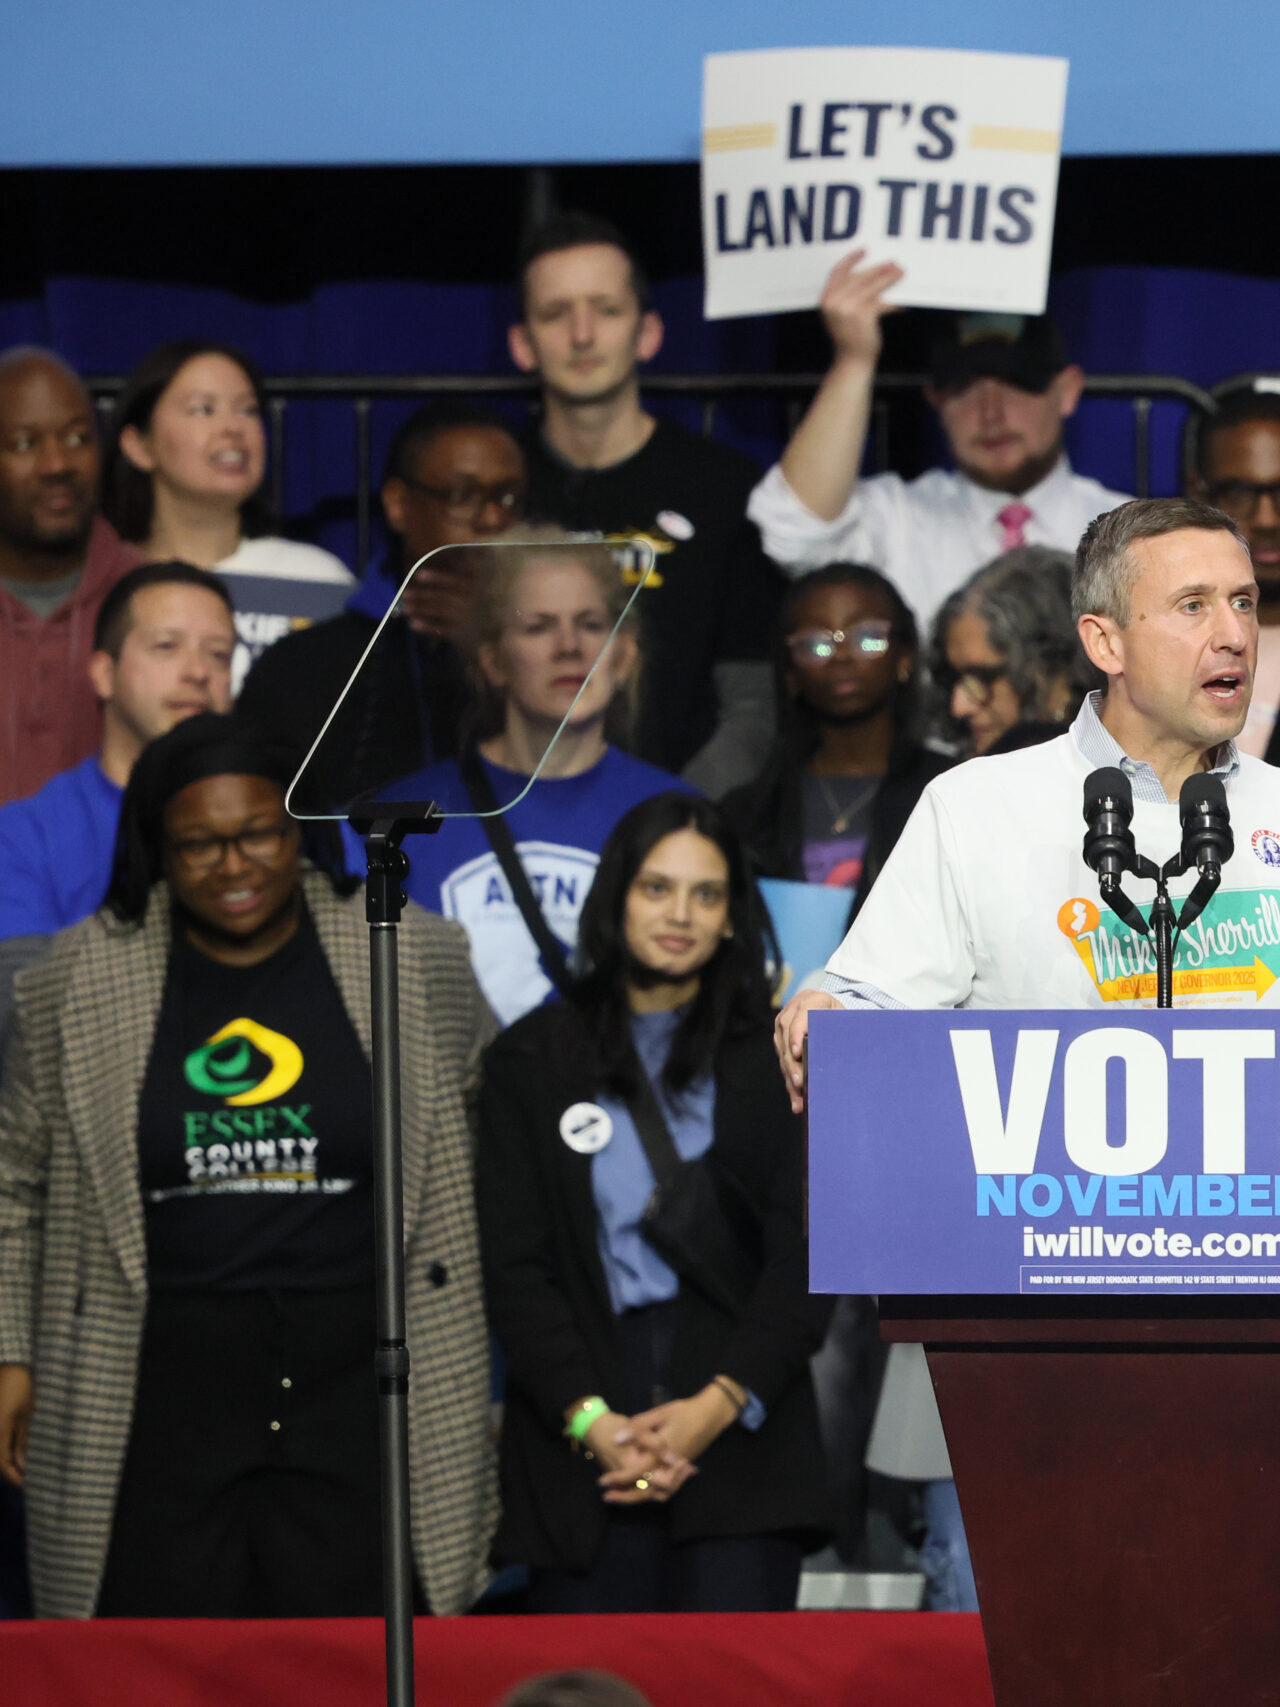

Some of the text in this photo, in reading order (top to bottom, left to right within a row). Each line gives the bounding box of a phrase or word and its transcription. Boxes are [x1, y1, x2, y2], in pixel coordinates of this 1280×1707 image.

[787, 102, 959, 162] LET'S
[714, 179, 1037, 254] LAND THIS
[1117, 971, 1256, 994] NEW JERY GOVERNOR 2025
[184, 1103, 314, 1147] ESSEX
[185, 1137, 319, 1168] COUNTY
[1030, 1275, 1042, 1285] PAID
[1043, 1275, 1053, 1285] FOR
[1054, 1275, 1062, 1285] BY
[1063, 1275, 1072, 1285] THE
[1073, 1275, 1085, 1285] NEW
[1086, 1275, 1105, 1285] JERSEY
[1106, 1275, 1138, 1285] DEMOCRATIC
[1139, 1275, 1153, 1285] STATE
[1154, 1275, 1182, 1285] COMMITTEE
[1200, 1275, 1214, 1285] STATE
[1215, 1275, 1233, 1285] STREET
[1235, 1275, 1258, 1285] TRENTON
[1259, 1275, 1266, 1285] NJ
